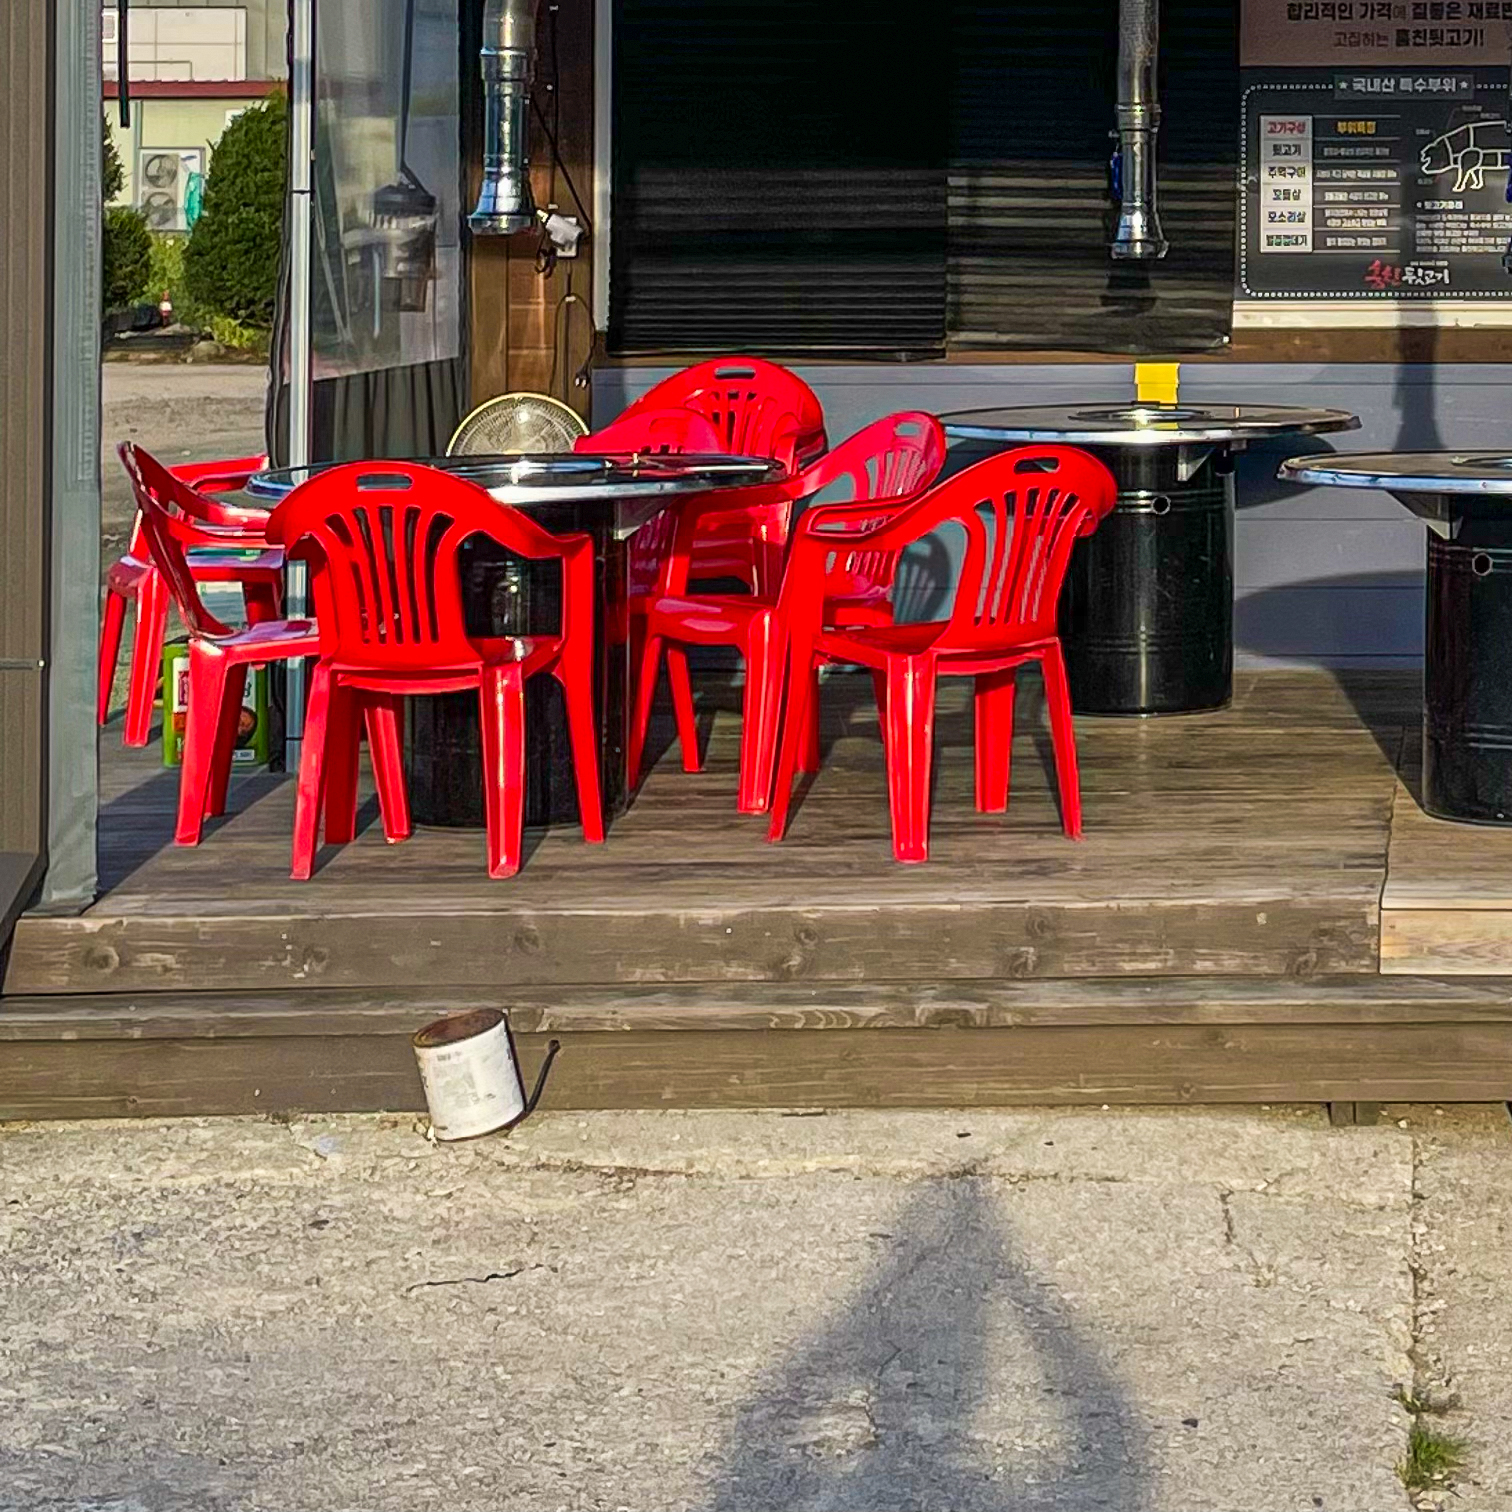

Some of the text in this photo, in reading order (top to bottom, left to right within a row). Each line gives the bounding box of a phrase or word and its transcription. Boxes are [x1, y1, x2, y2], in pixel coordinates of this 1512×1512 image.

[1287, 2, 1353, 21] 합리적인
[1352, 76, 1456, 92] 국내산 특수부위
